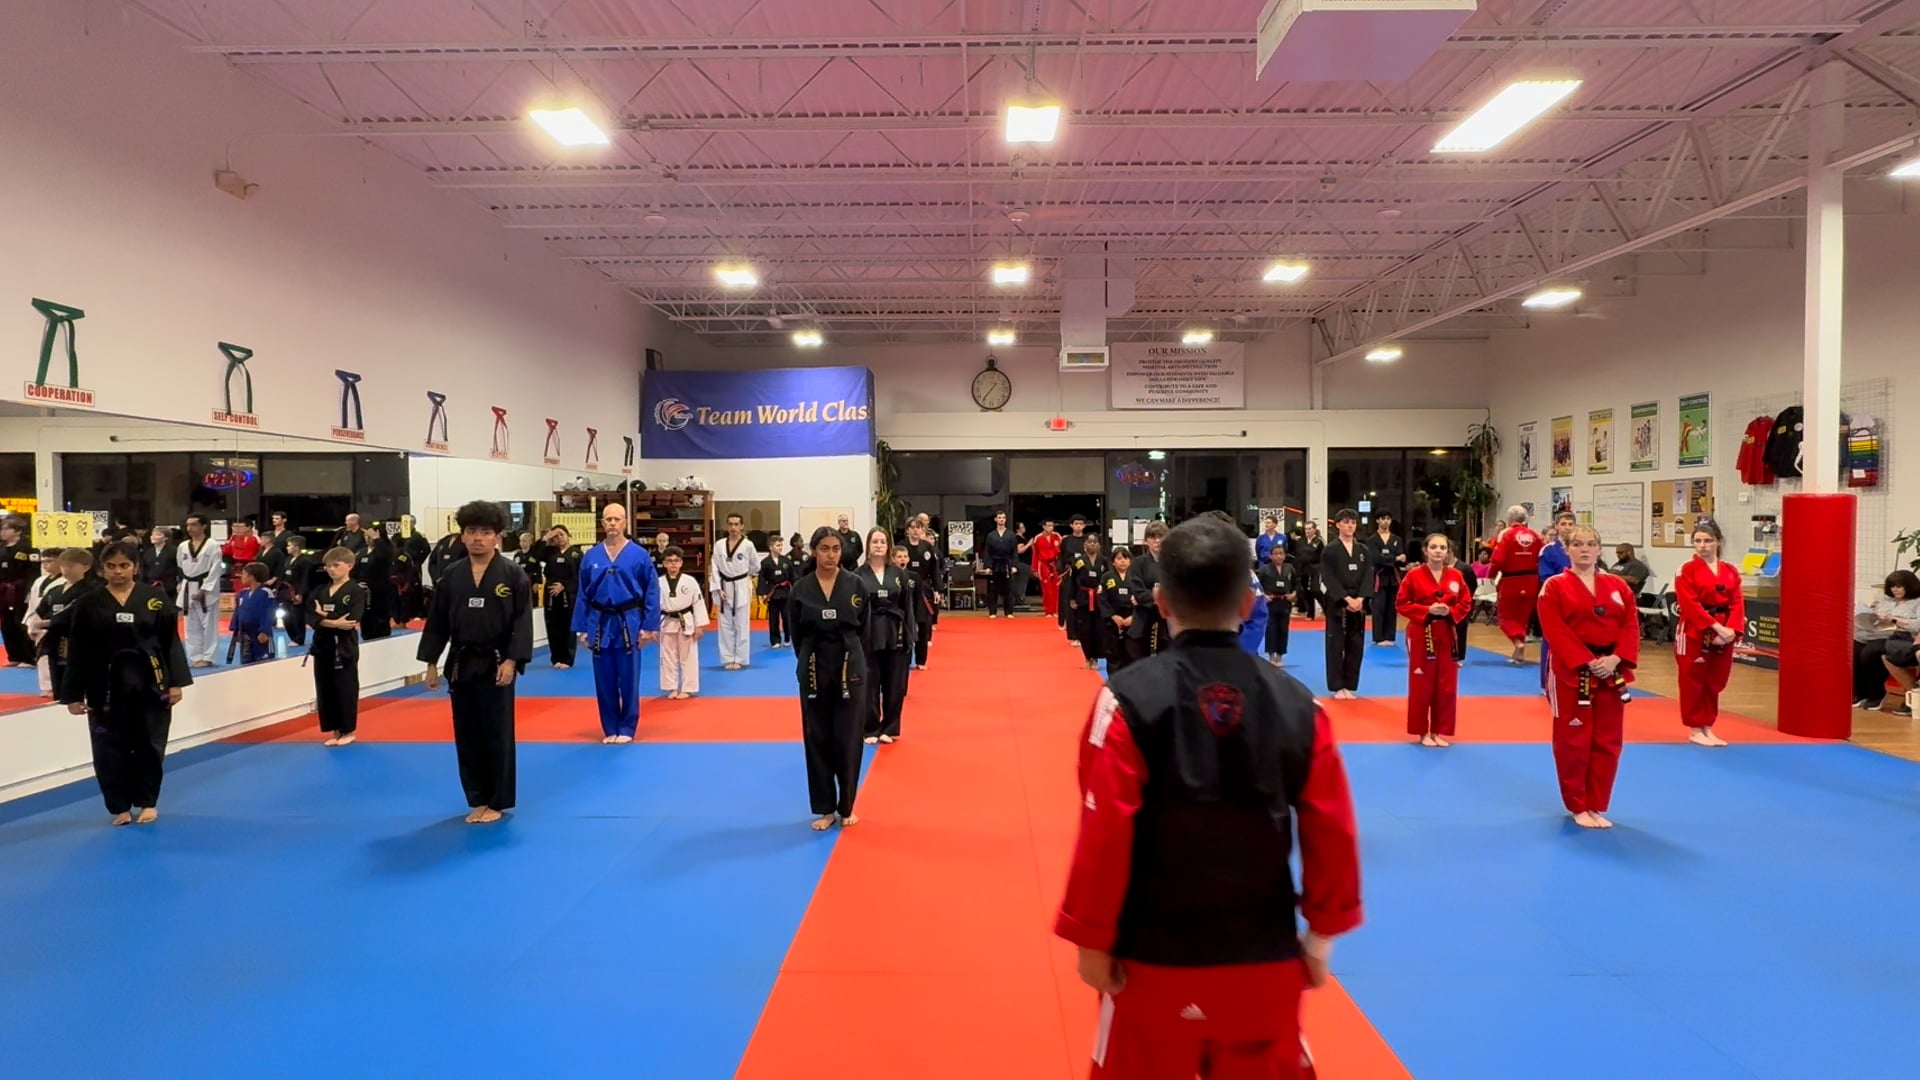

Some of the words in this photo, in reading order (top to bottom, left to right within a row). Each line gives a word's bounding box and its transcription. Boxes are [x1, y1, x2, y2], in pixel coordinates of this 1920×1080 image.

[1148, 347, 1168, 355] OUR
[1170, 346, 1207, 355] MISSION
[27, 384, 92, 403] COOPERATION
[696, 406, 753, 426] Team
[757, 400, 818, 425] World
[821, 399, 869, 422] Clas
